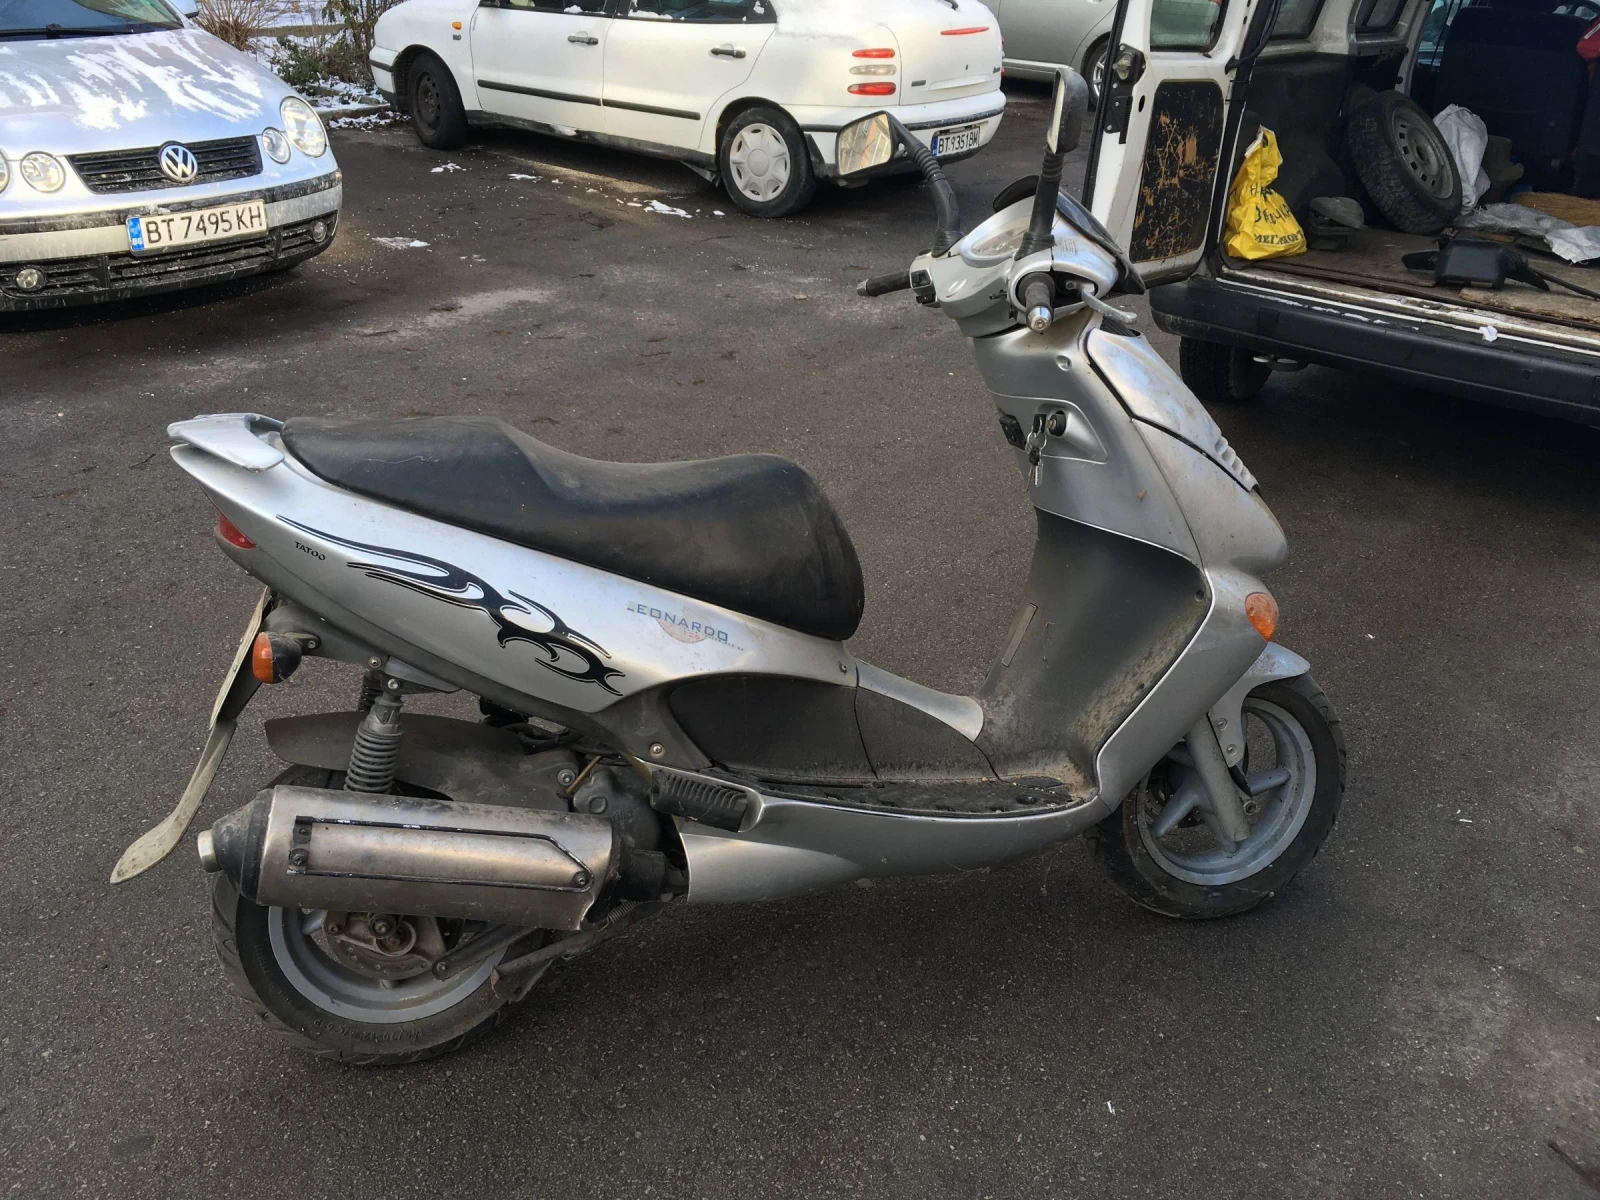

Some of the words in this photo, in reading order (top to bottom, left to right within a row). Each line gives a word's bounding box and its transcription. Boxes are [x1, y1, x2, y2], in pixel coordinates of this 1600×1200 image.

[181, 211, 233, 239] 7495
[235, 205, 263, 231] KH
[295, 541, 326, 561] TATOO
